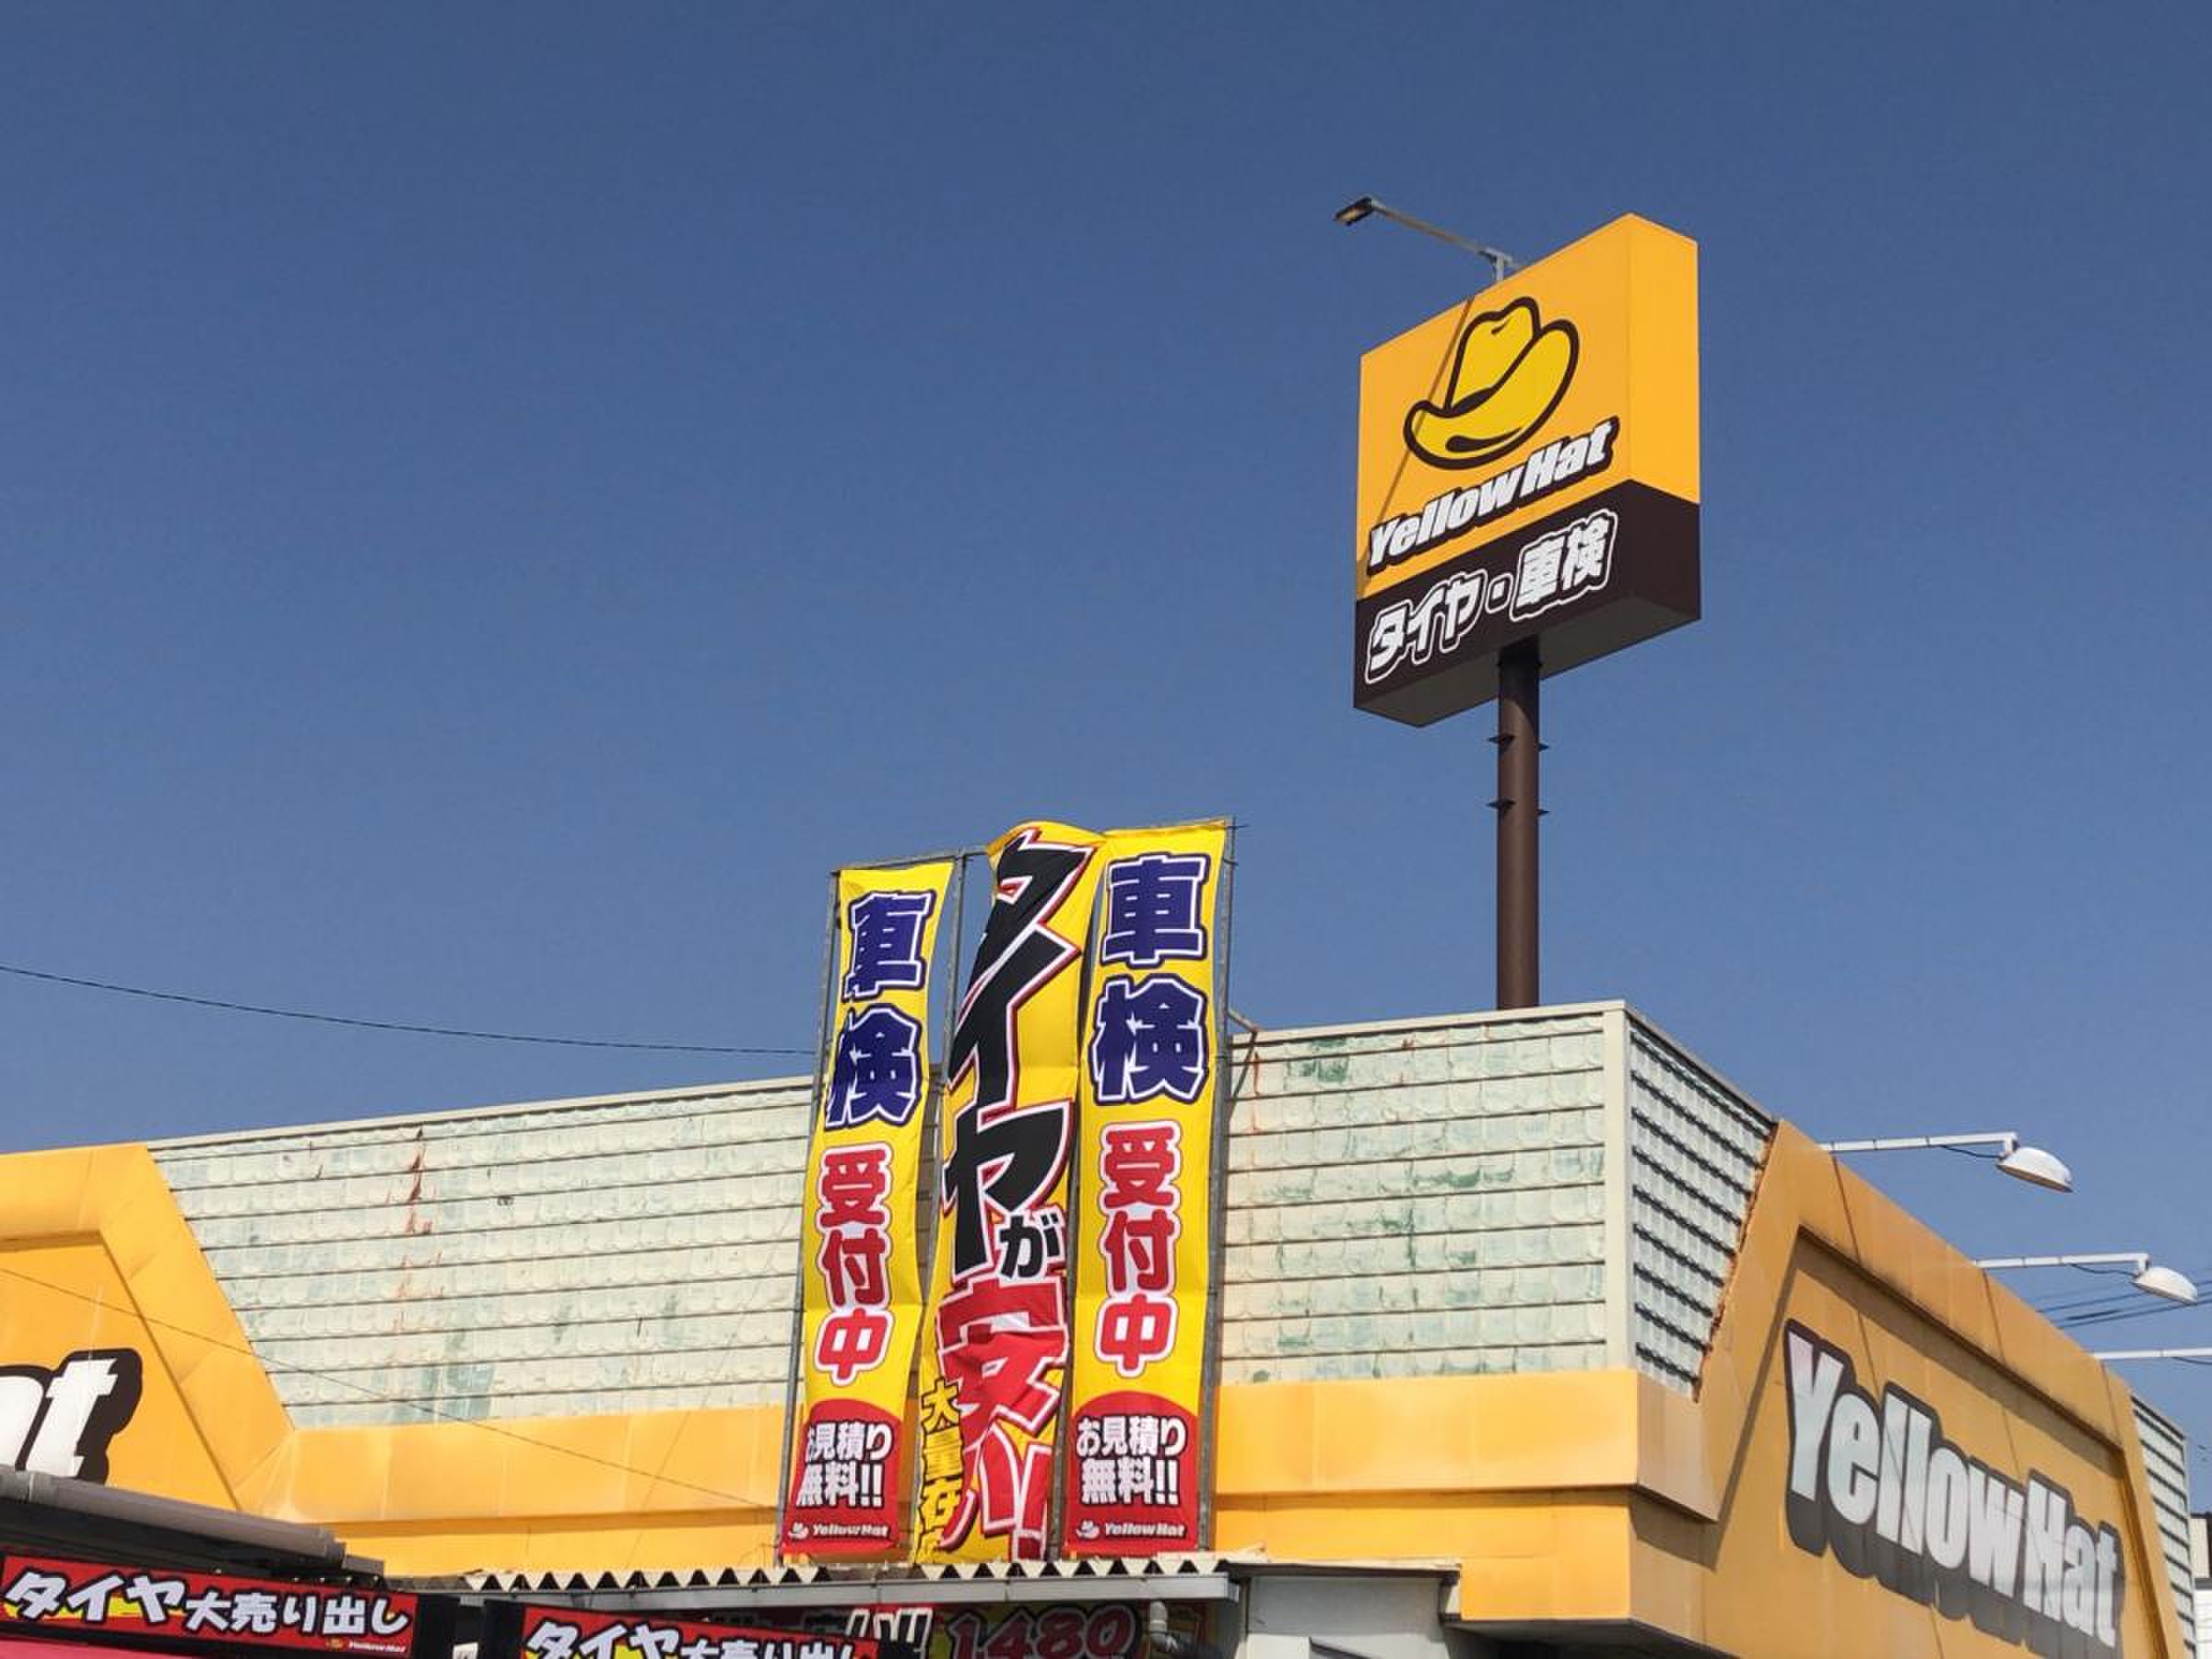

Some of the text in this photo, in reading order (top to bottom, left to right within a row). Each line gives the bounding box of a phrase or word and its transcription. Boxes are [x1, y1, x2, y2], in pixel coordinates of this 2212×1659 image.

[805, 1420, 893, 1464] 見積り
[1076, 1414, 1186, 1457] お見積り
